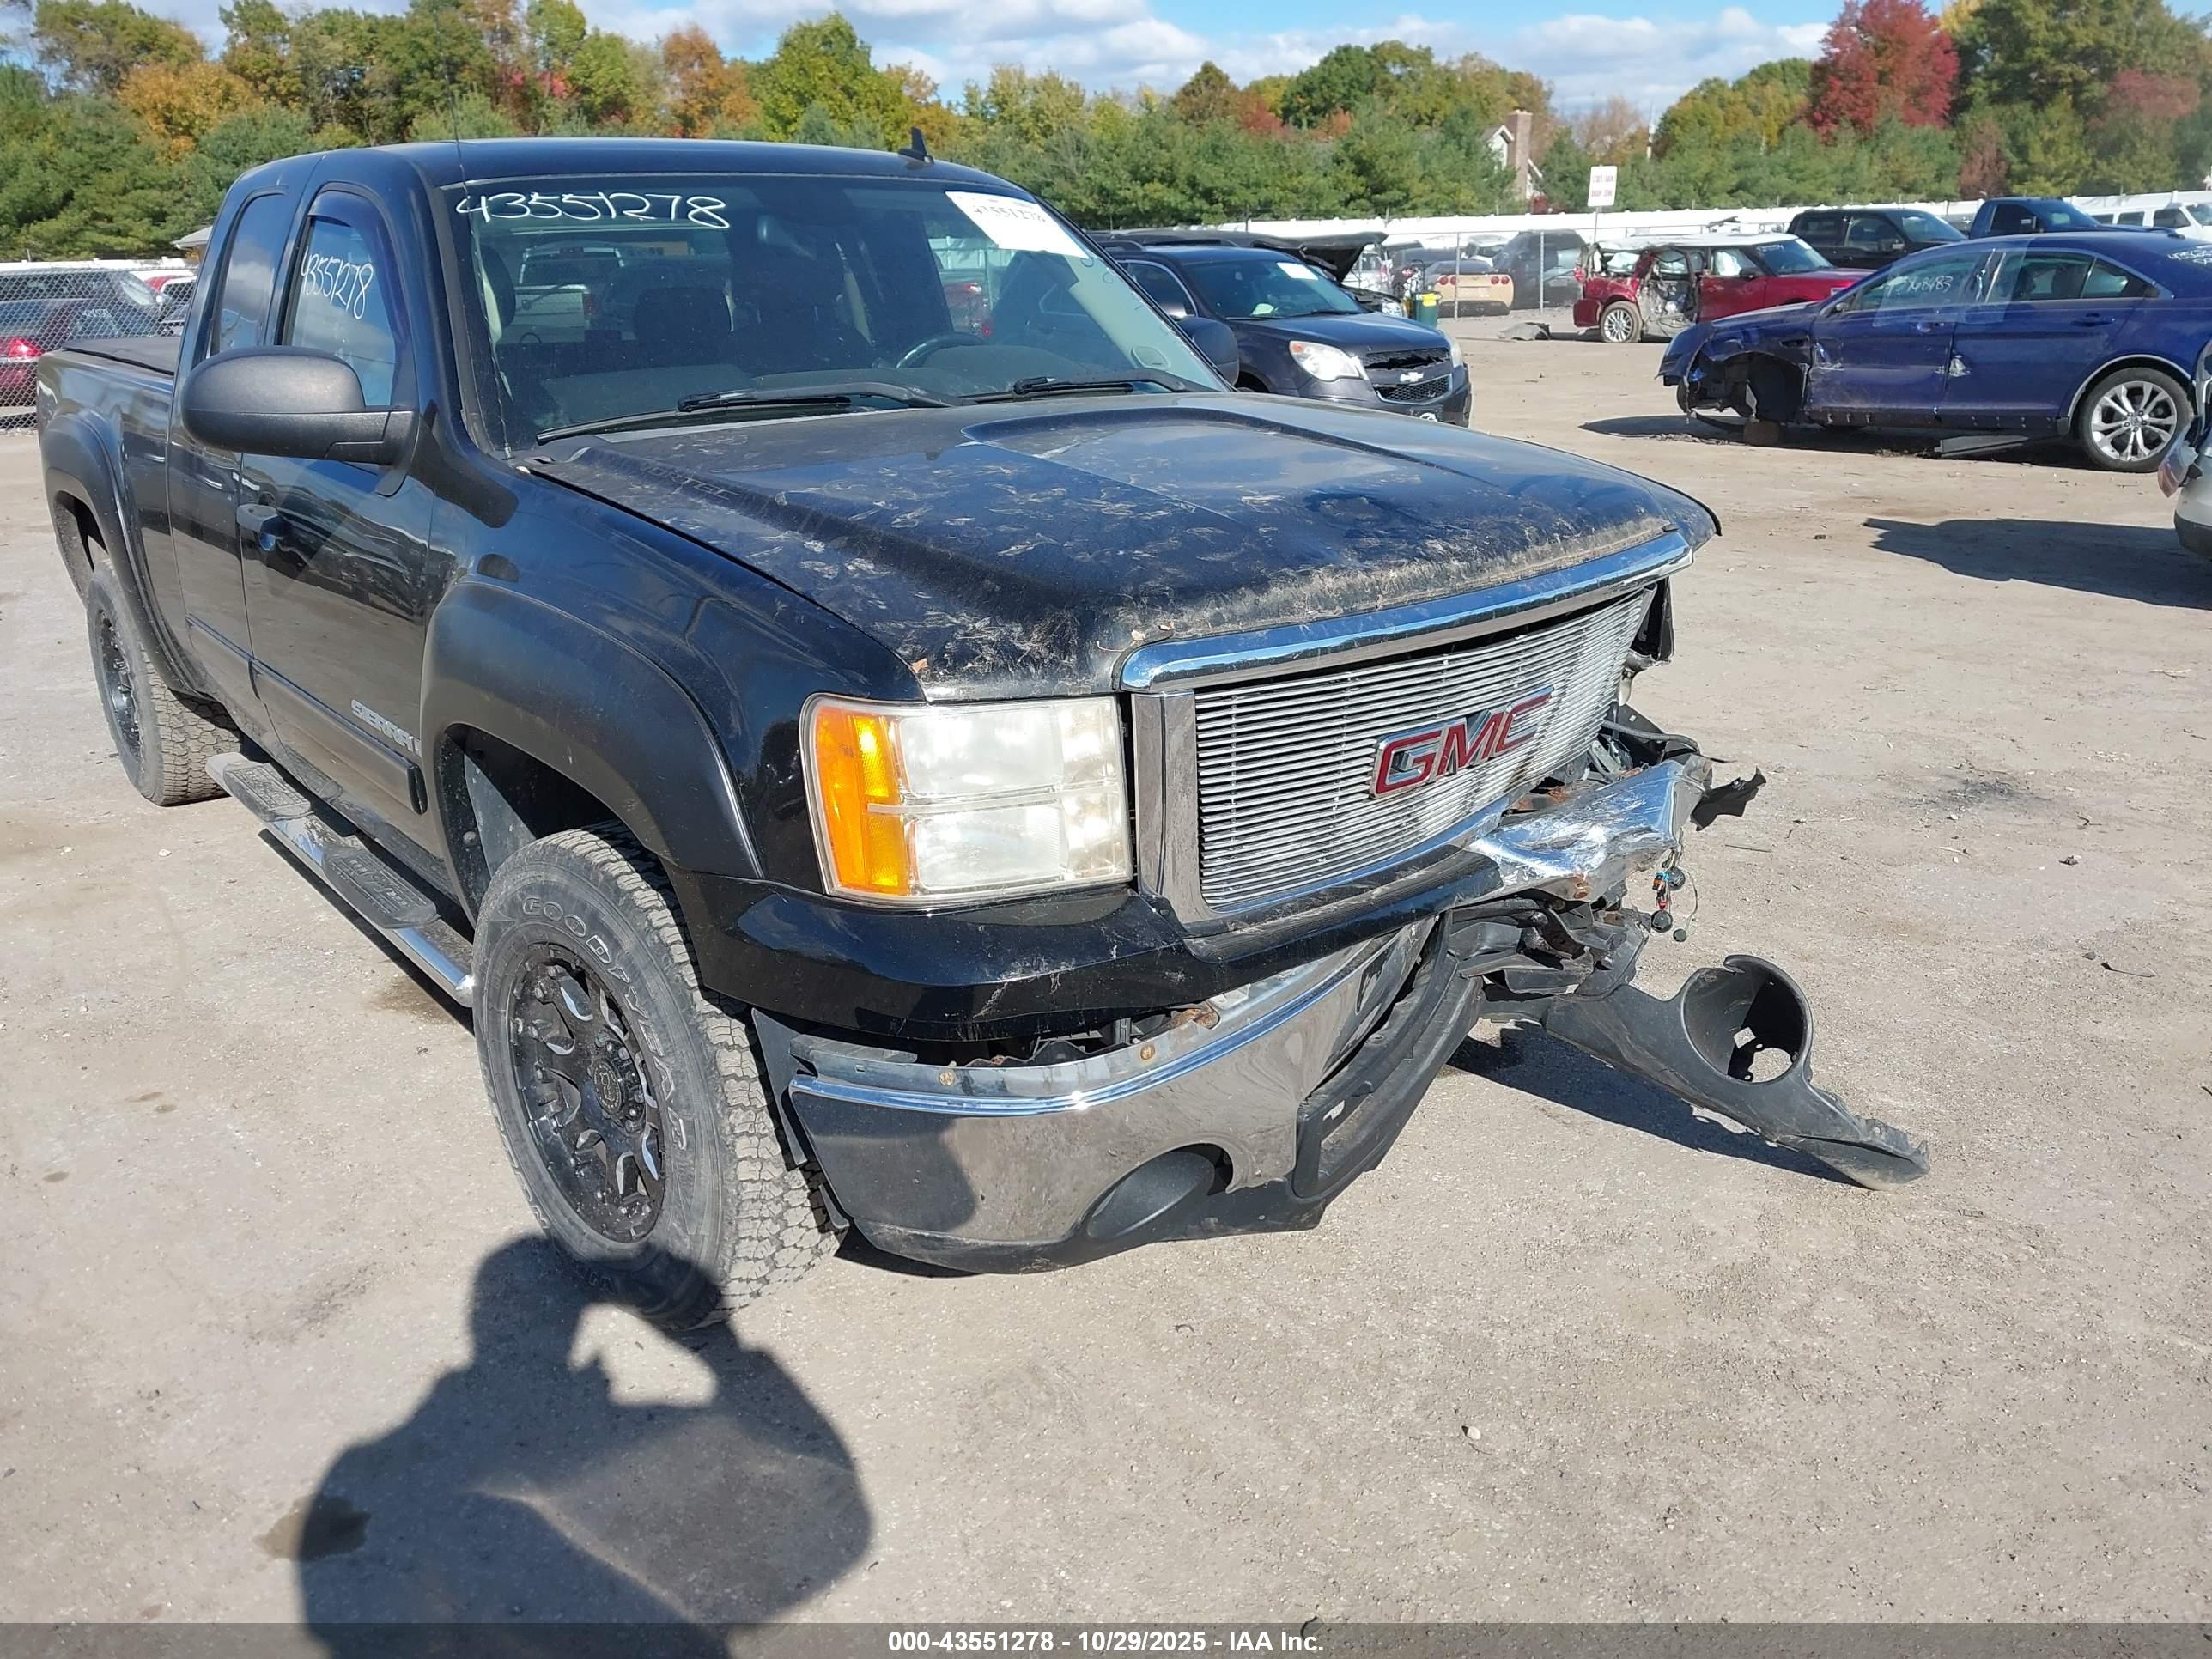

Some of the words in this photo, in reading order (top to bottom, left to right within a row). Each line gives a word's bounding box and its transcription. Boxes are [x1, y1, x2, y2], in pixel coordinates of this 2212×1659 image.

[456, 191, 729, 229] 43551278
[301, 246, 374, 319] 43551278
[1370, 686, 1556, 799] GMC
[522, 896, 687, 1151] GOODYEAR
